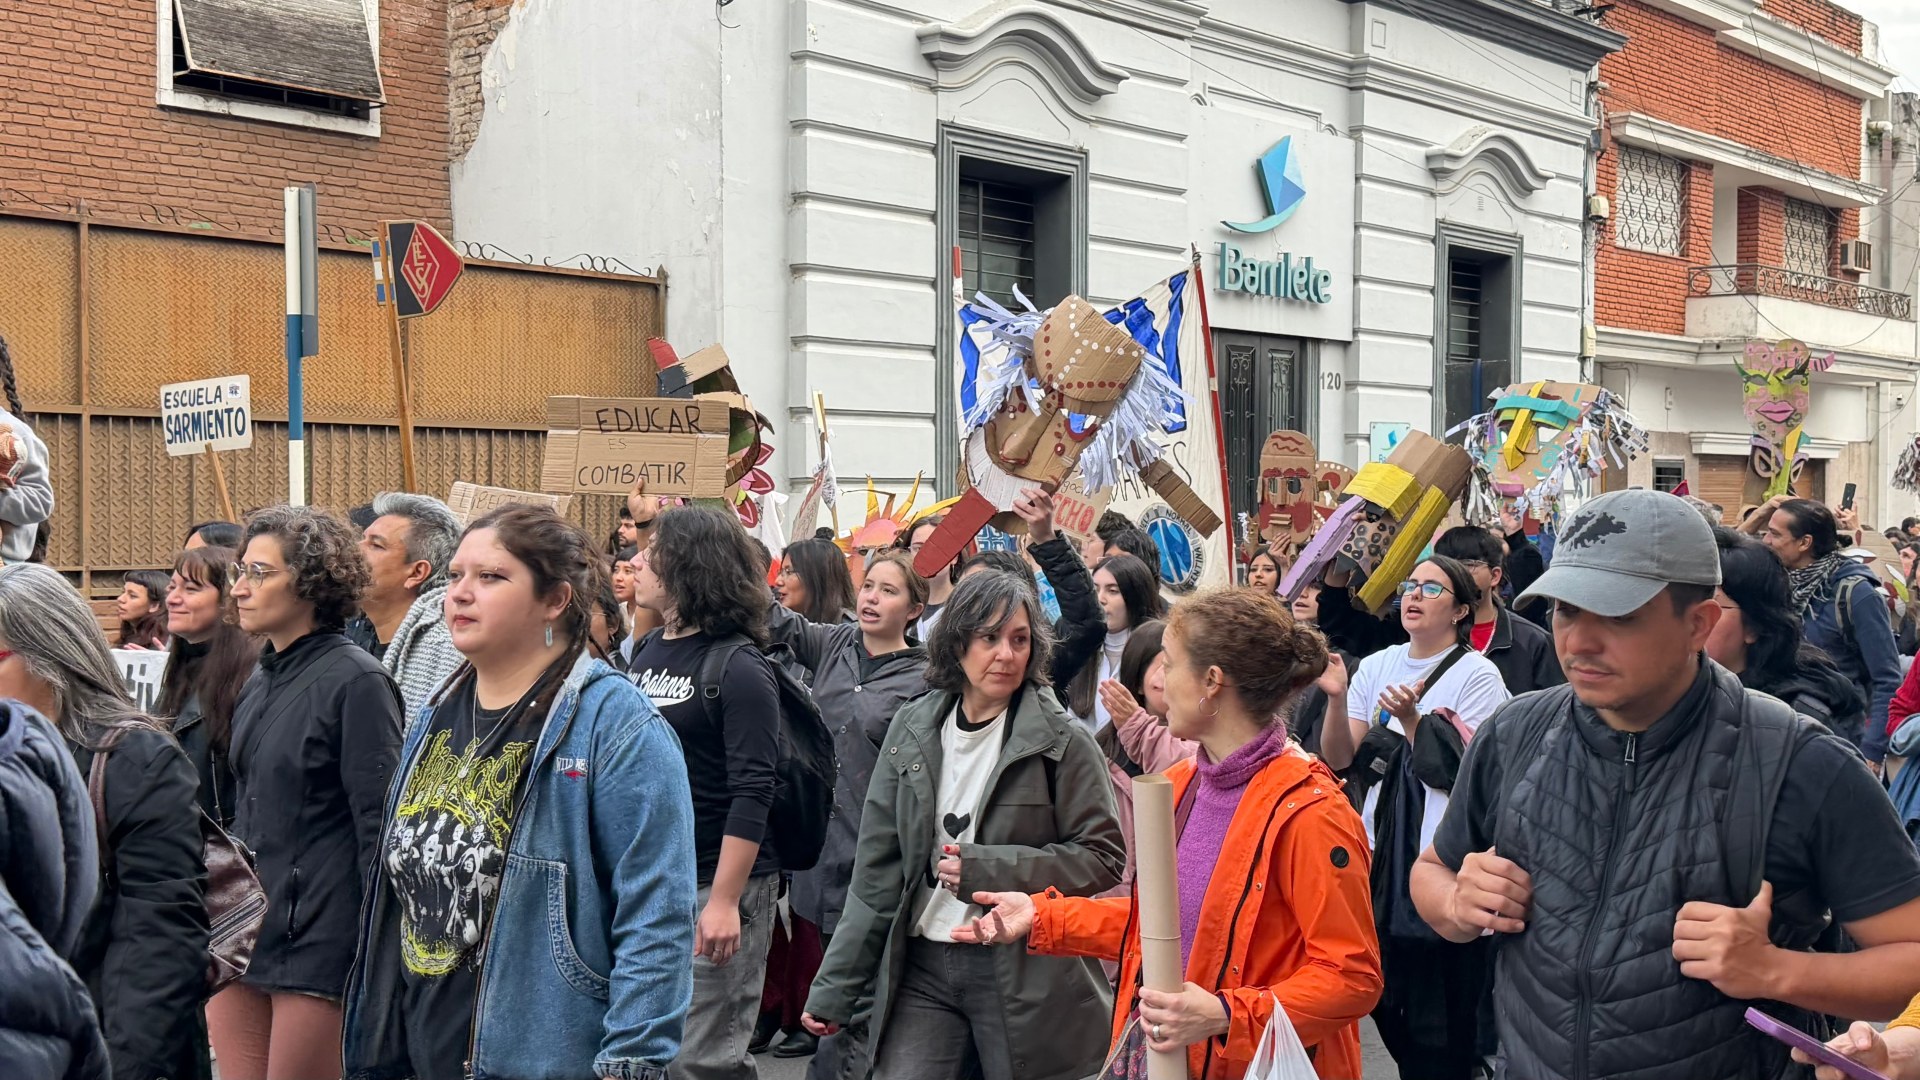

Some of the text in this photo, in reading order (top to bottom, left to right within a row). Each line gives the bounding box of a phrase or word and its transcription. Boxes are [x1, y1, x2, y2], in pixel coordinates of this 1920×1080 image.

[1219, 242, 1332, 304] Barrilete
[1320, 372, 1341, 391] 120
[164, 385, 222, 409] ESCUELA
[166, 406, 246, 444] SARMIENTO
[596, 406, 703, 433] EDUCAR
[608, 438, 627, 450] ES
[578, 461, 687, 486] COMBATIR
[640, 667, 692, 699] Balance
